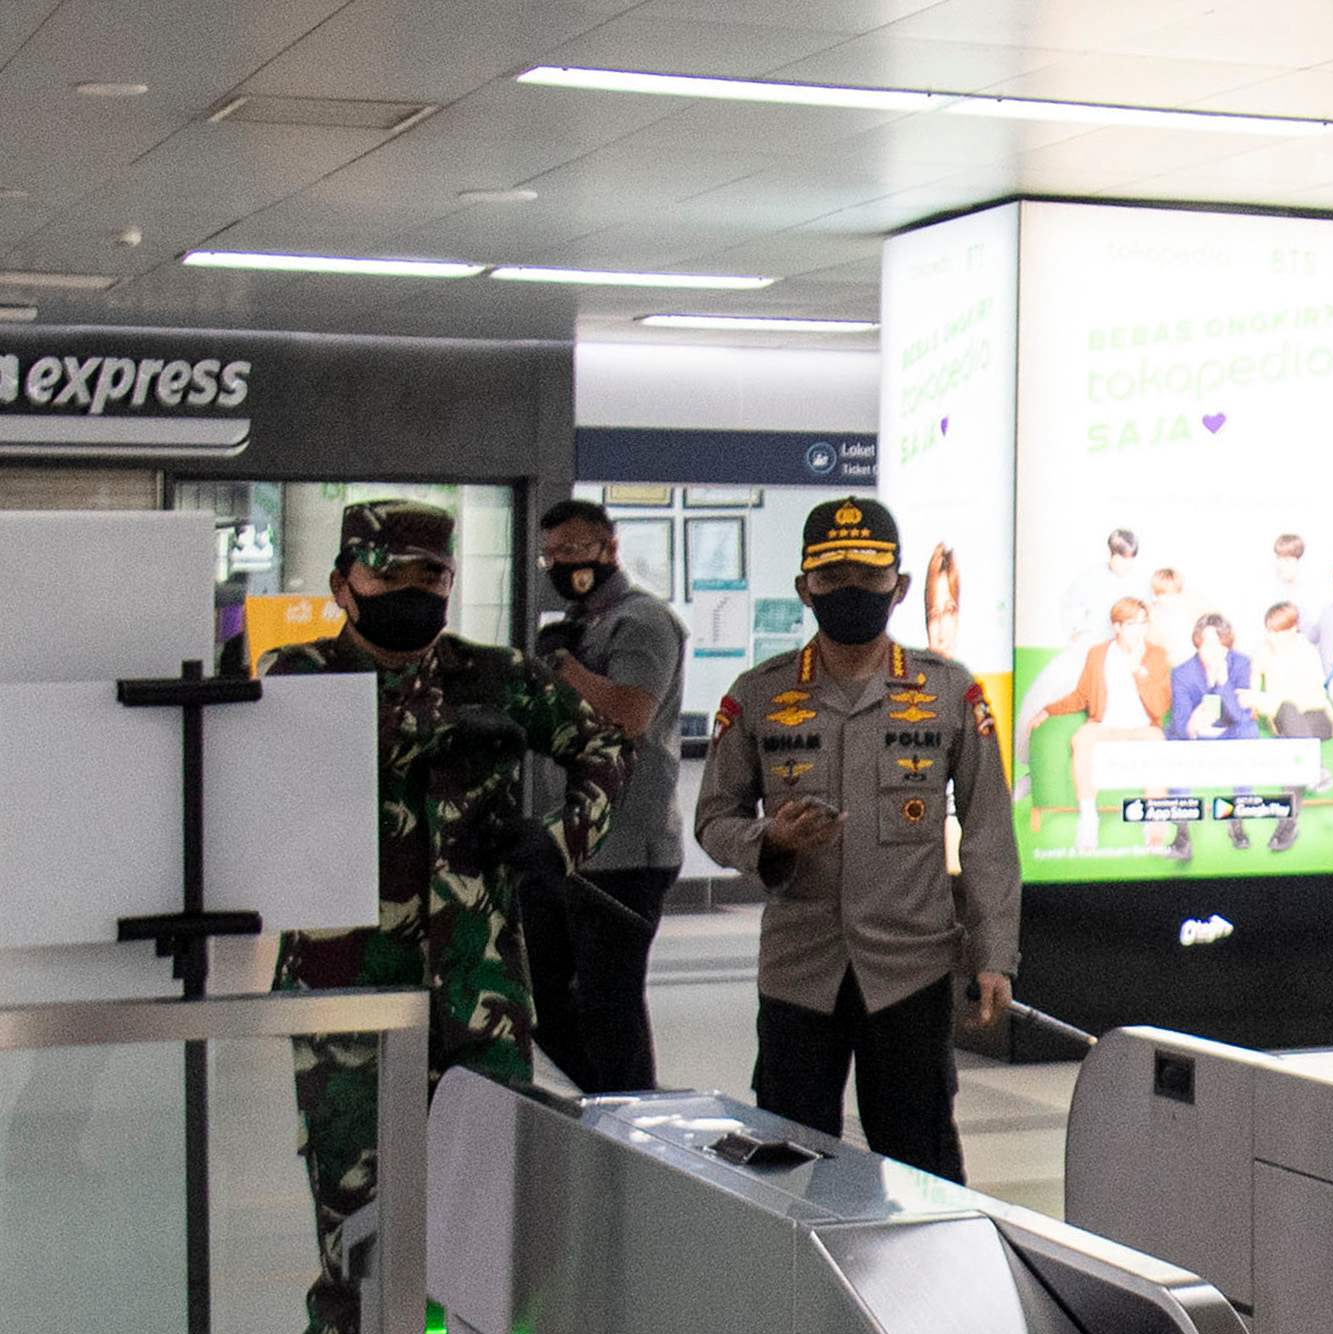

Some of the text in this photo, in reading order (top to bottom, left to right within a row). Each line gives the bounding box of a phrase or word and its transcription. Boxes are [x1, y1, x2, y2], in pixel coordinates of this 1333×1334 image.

[1086, 318, 1195, 353] BEBAS
[25, 354, 252, 415] express
[1085, 413, 1194, 455] SAJA
[841, 442, 875, 457] Loket
[842, 463, 871, 475] Ticket
[884, 732, 942, 748] POLRI
